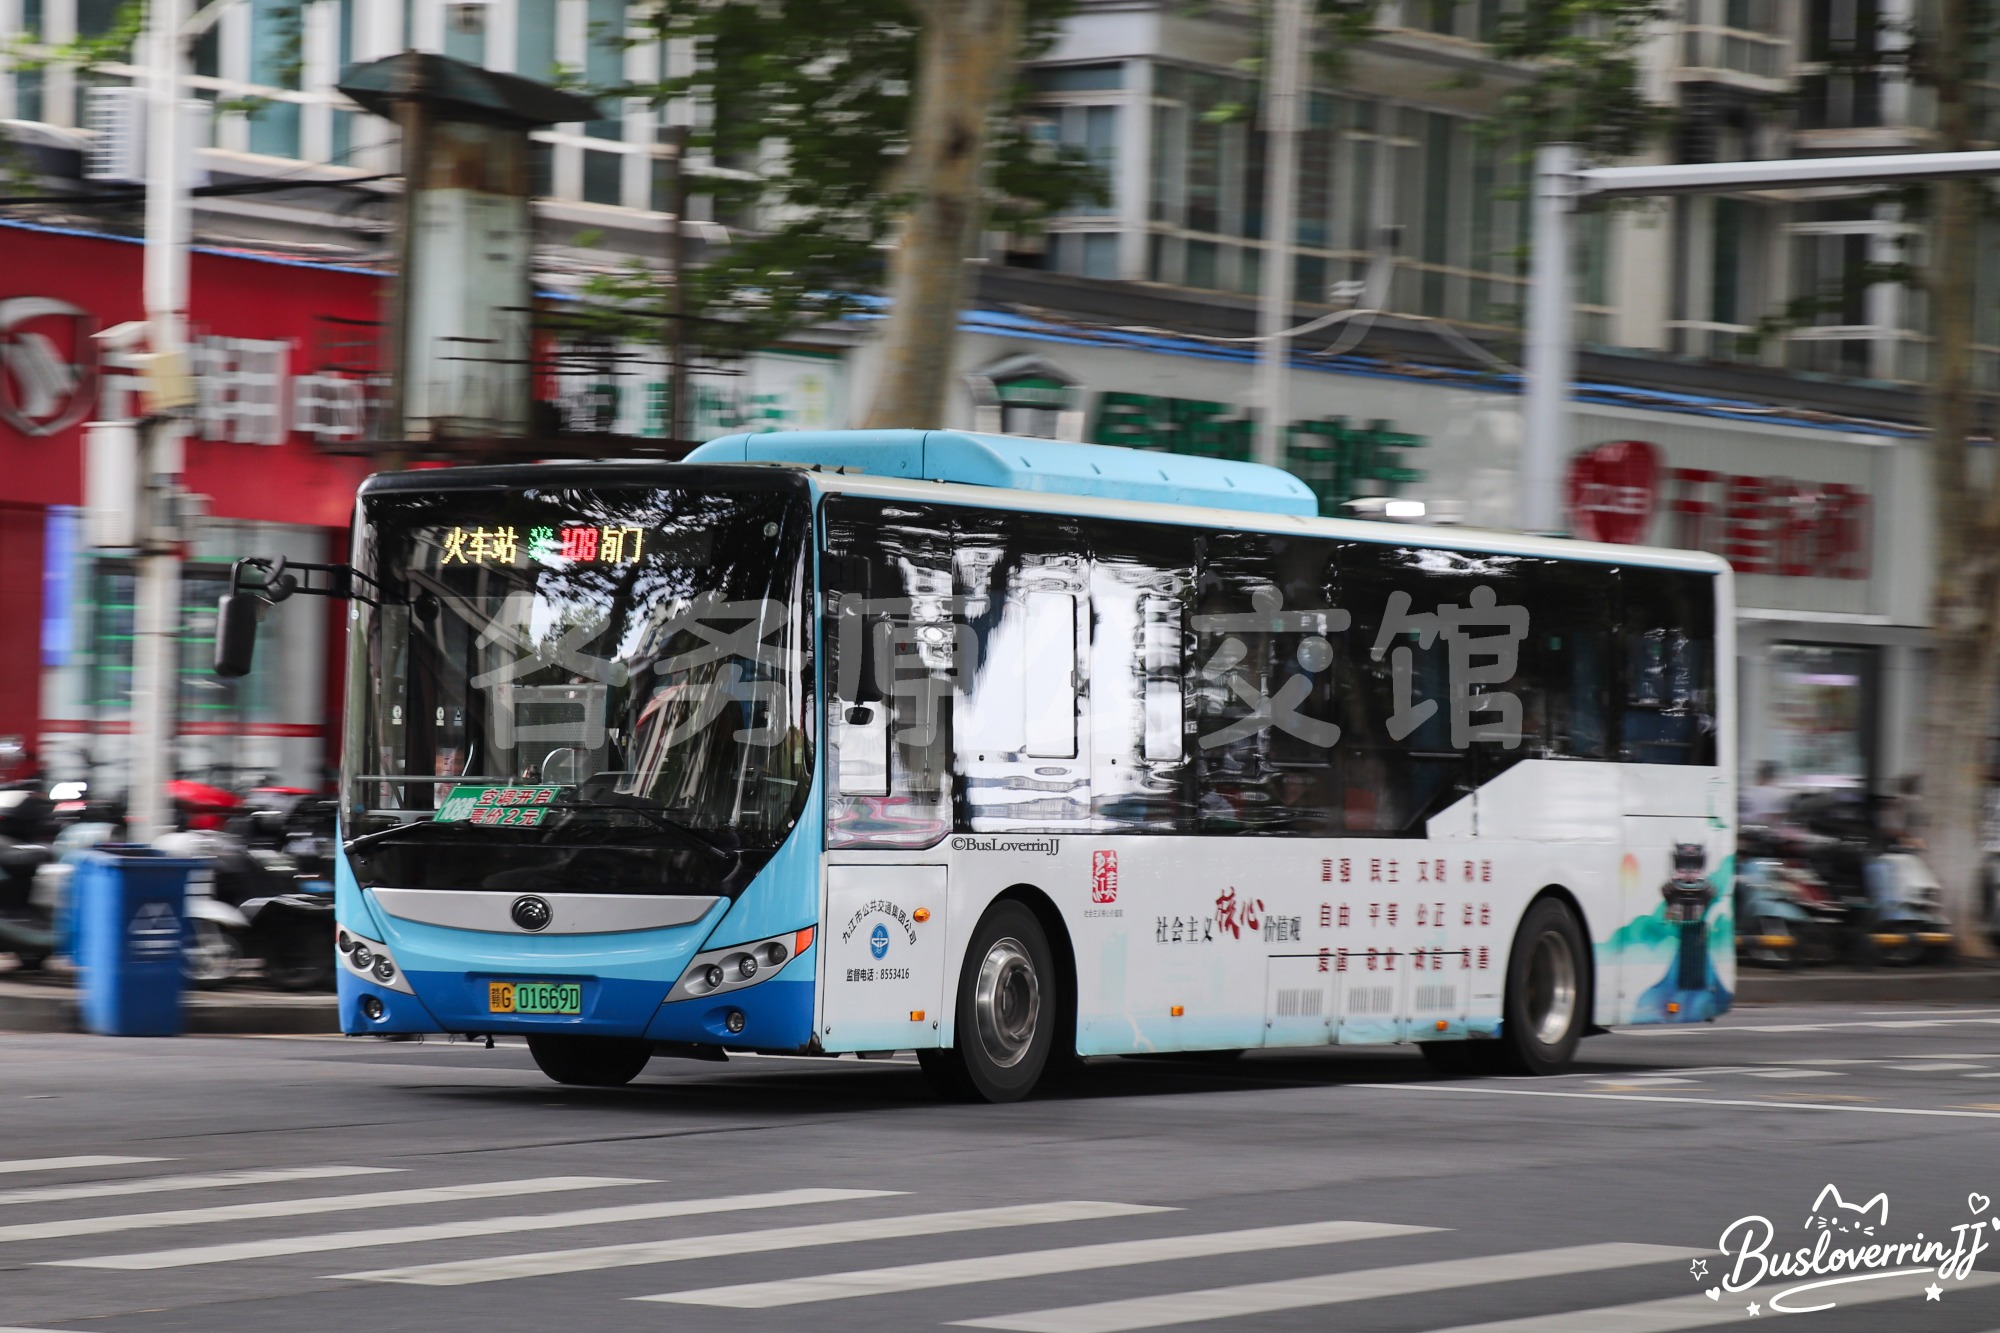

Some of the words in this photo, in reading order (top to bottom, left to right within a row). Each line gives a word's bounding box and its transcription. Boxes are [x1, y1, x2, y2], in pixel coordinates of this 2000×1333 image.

[441, 526, 519, 564] 火车站
[476, 788, 554, 806] 空调开启
[470, 807, 540, 826] 票价2元
[1370, 857, 1400, 882] 民主
[1417, 858, 1446, 883] 文明
[842, 899, 917, 945] 九江市公共交通集团公司
[1156, 885, 1301, 942] 社会主义核心价值观
[1320, 902, 1350, 927] 自由
[1368, 902, 1399, 928] 平等
[1416, 902, 1445, 926] 公正
